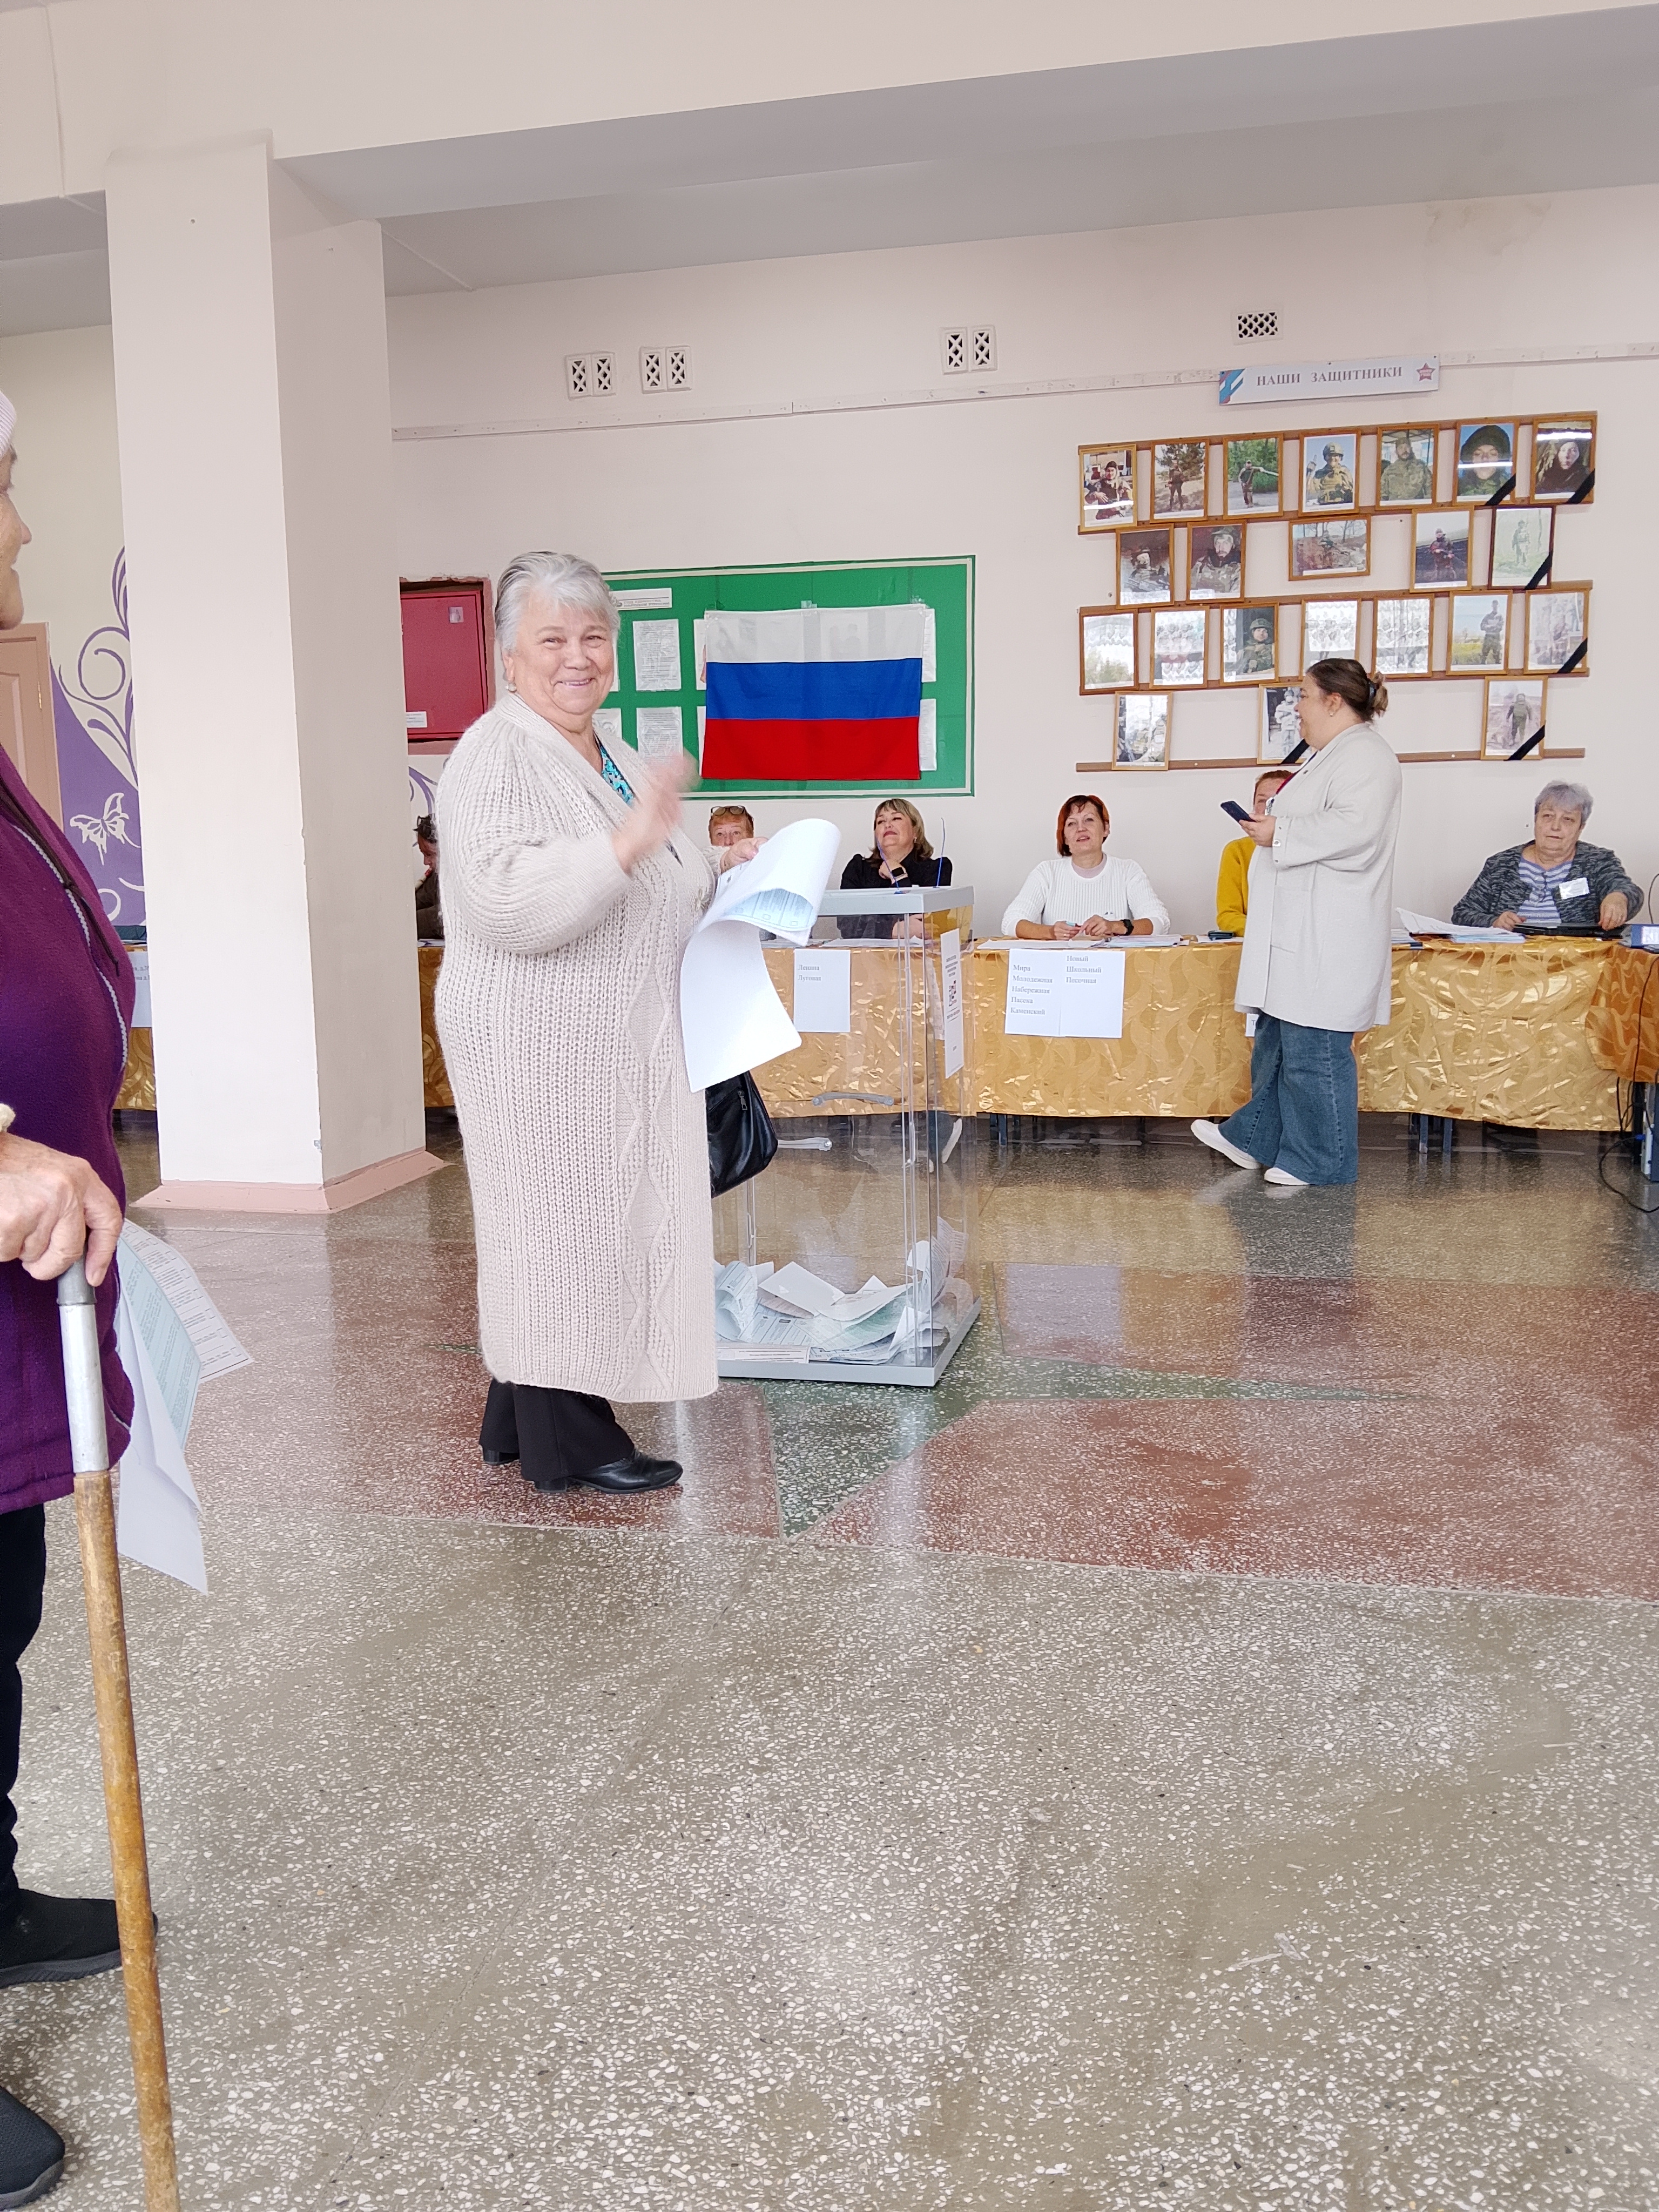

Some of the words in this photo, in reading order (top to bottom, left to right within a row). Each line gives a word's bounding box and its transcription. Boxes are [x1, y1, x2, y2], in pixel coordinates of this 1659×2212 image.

[1257, 373, 1300, 386] НАШИ
[1311, 366, 1402, 383] ЗАЩИТНИКИ
[798, 974, 822, 982] Луговая
[1013, 975, 1053, 983] Молодежная
[1012, 986, 1050, 994] Набережная
